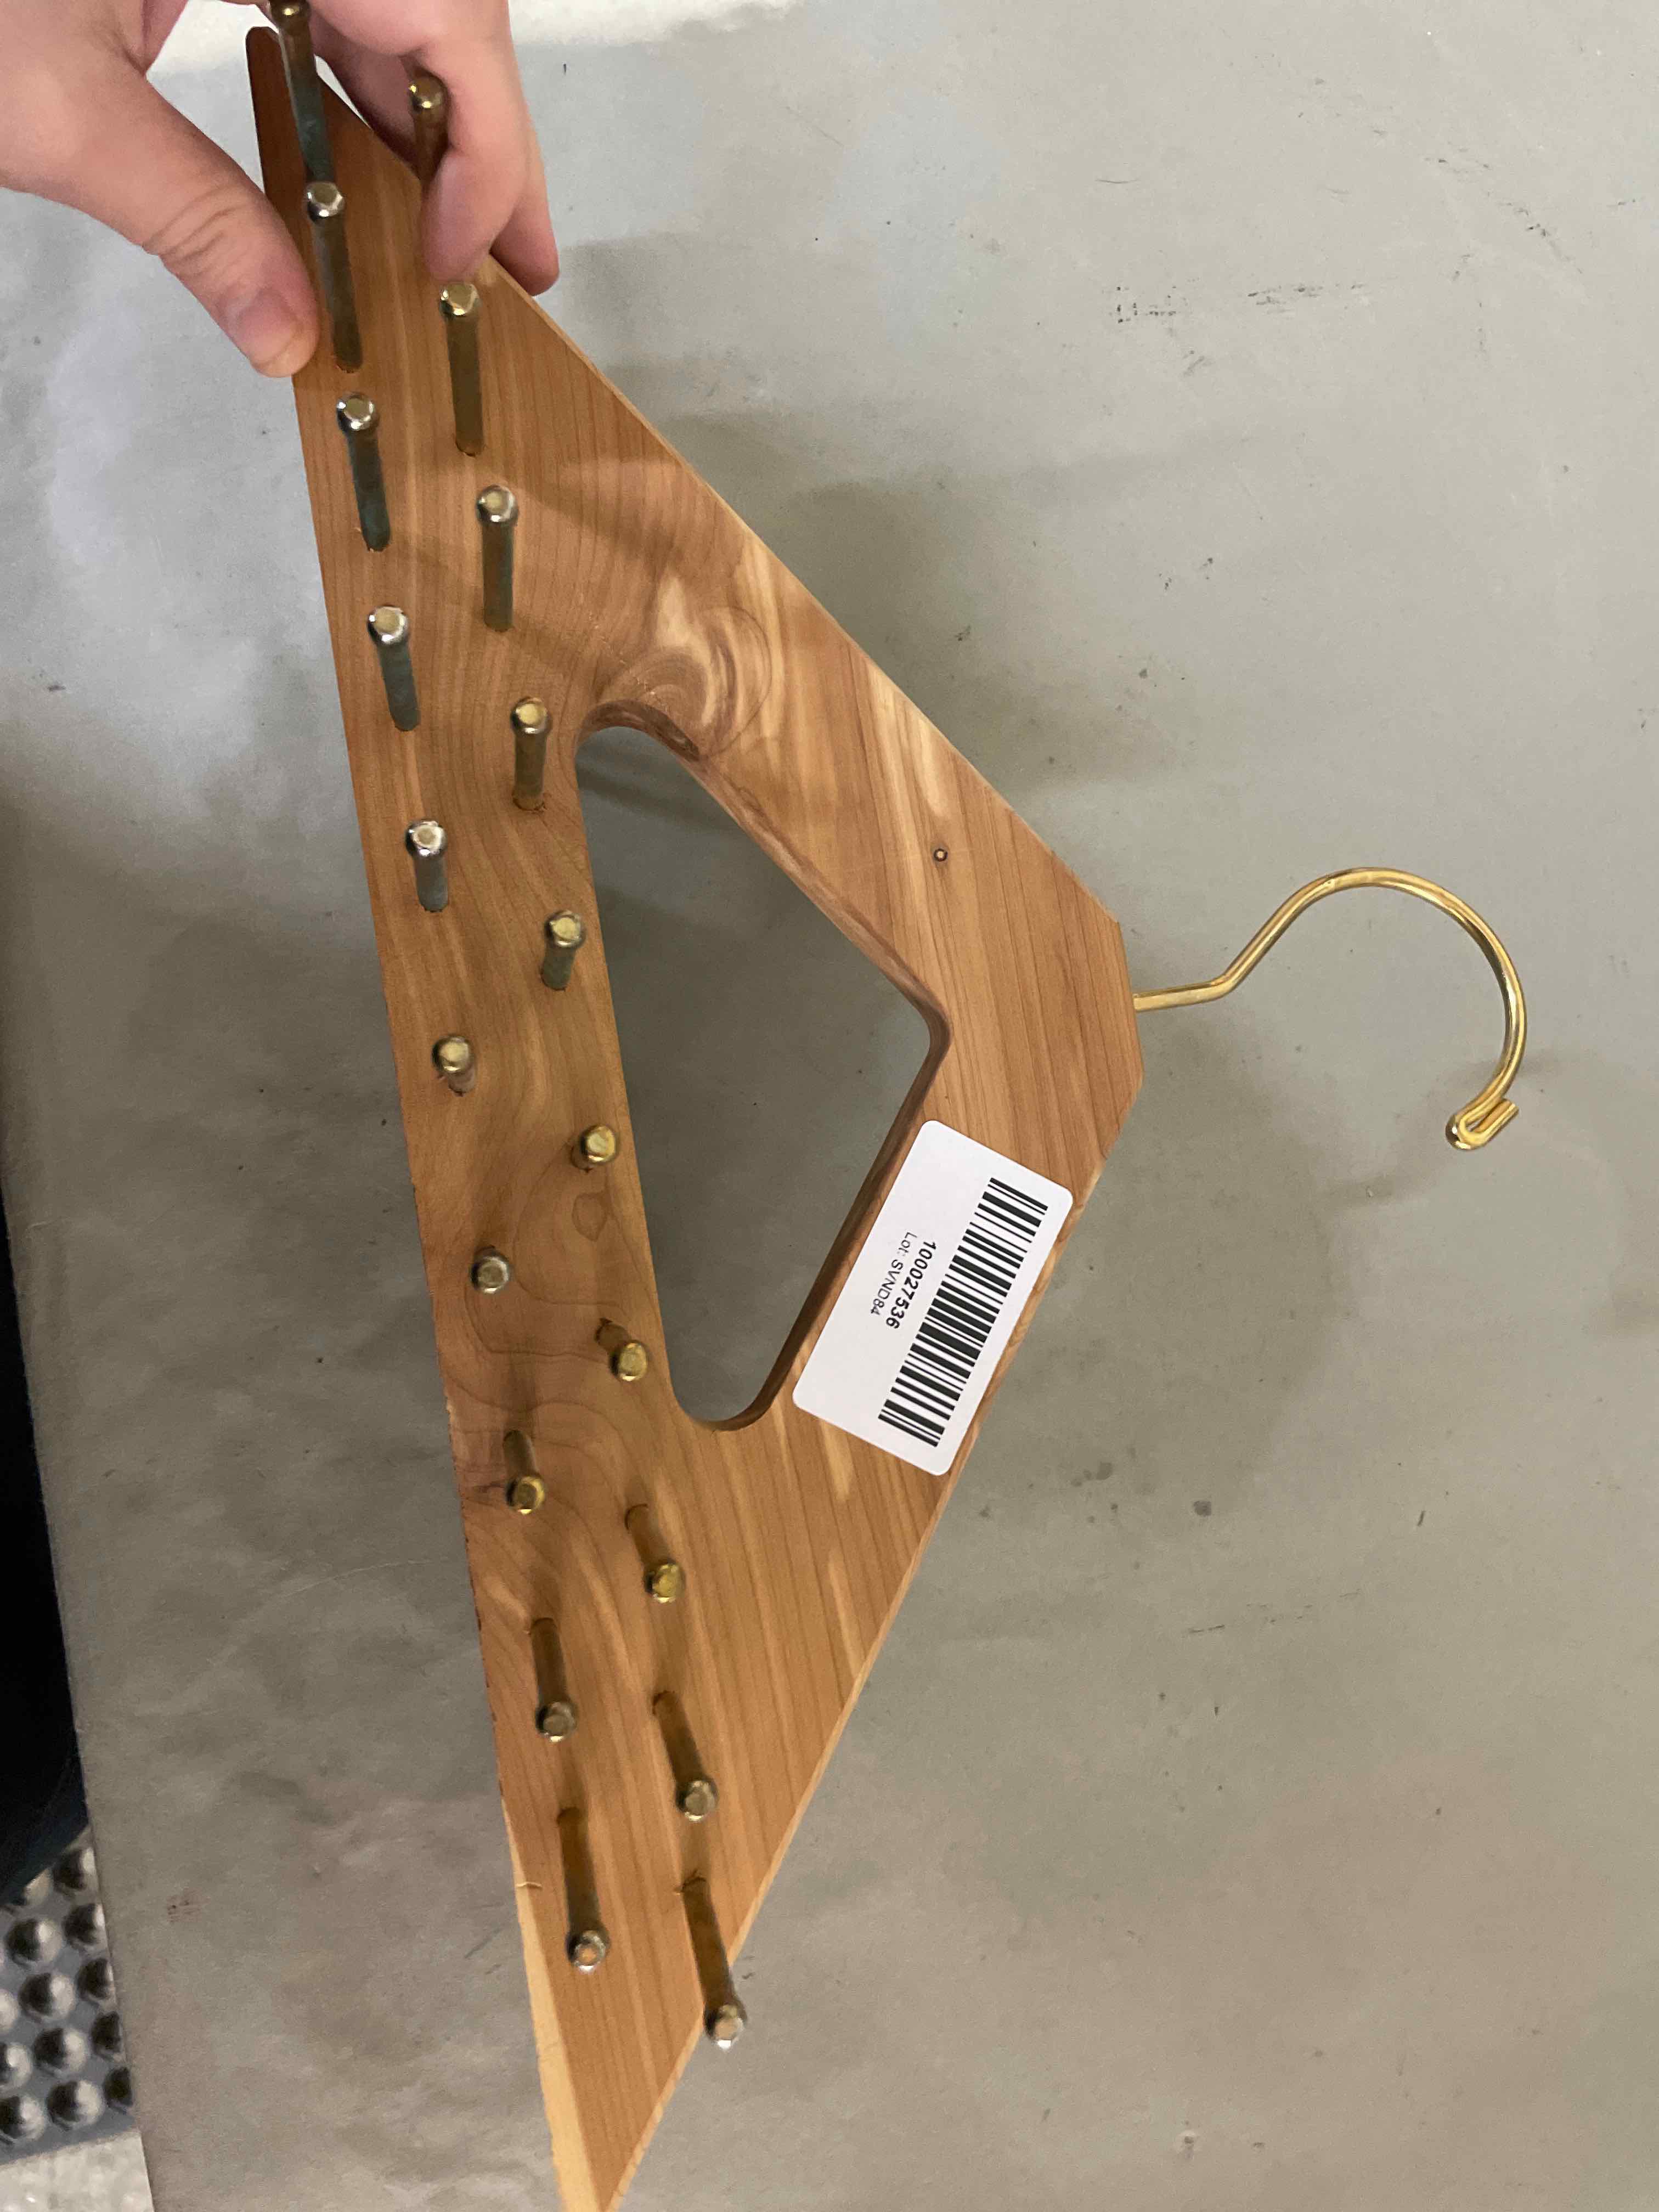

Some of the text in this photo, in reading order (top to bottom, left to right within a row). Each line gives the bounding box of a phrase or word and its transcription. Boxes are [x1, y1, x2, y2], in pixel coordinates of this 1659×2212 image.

[870, 1232, 918, 1316] Lot: SVND84
[885, 1242, 937, 1329] 100027536
